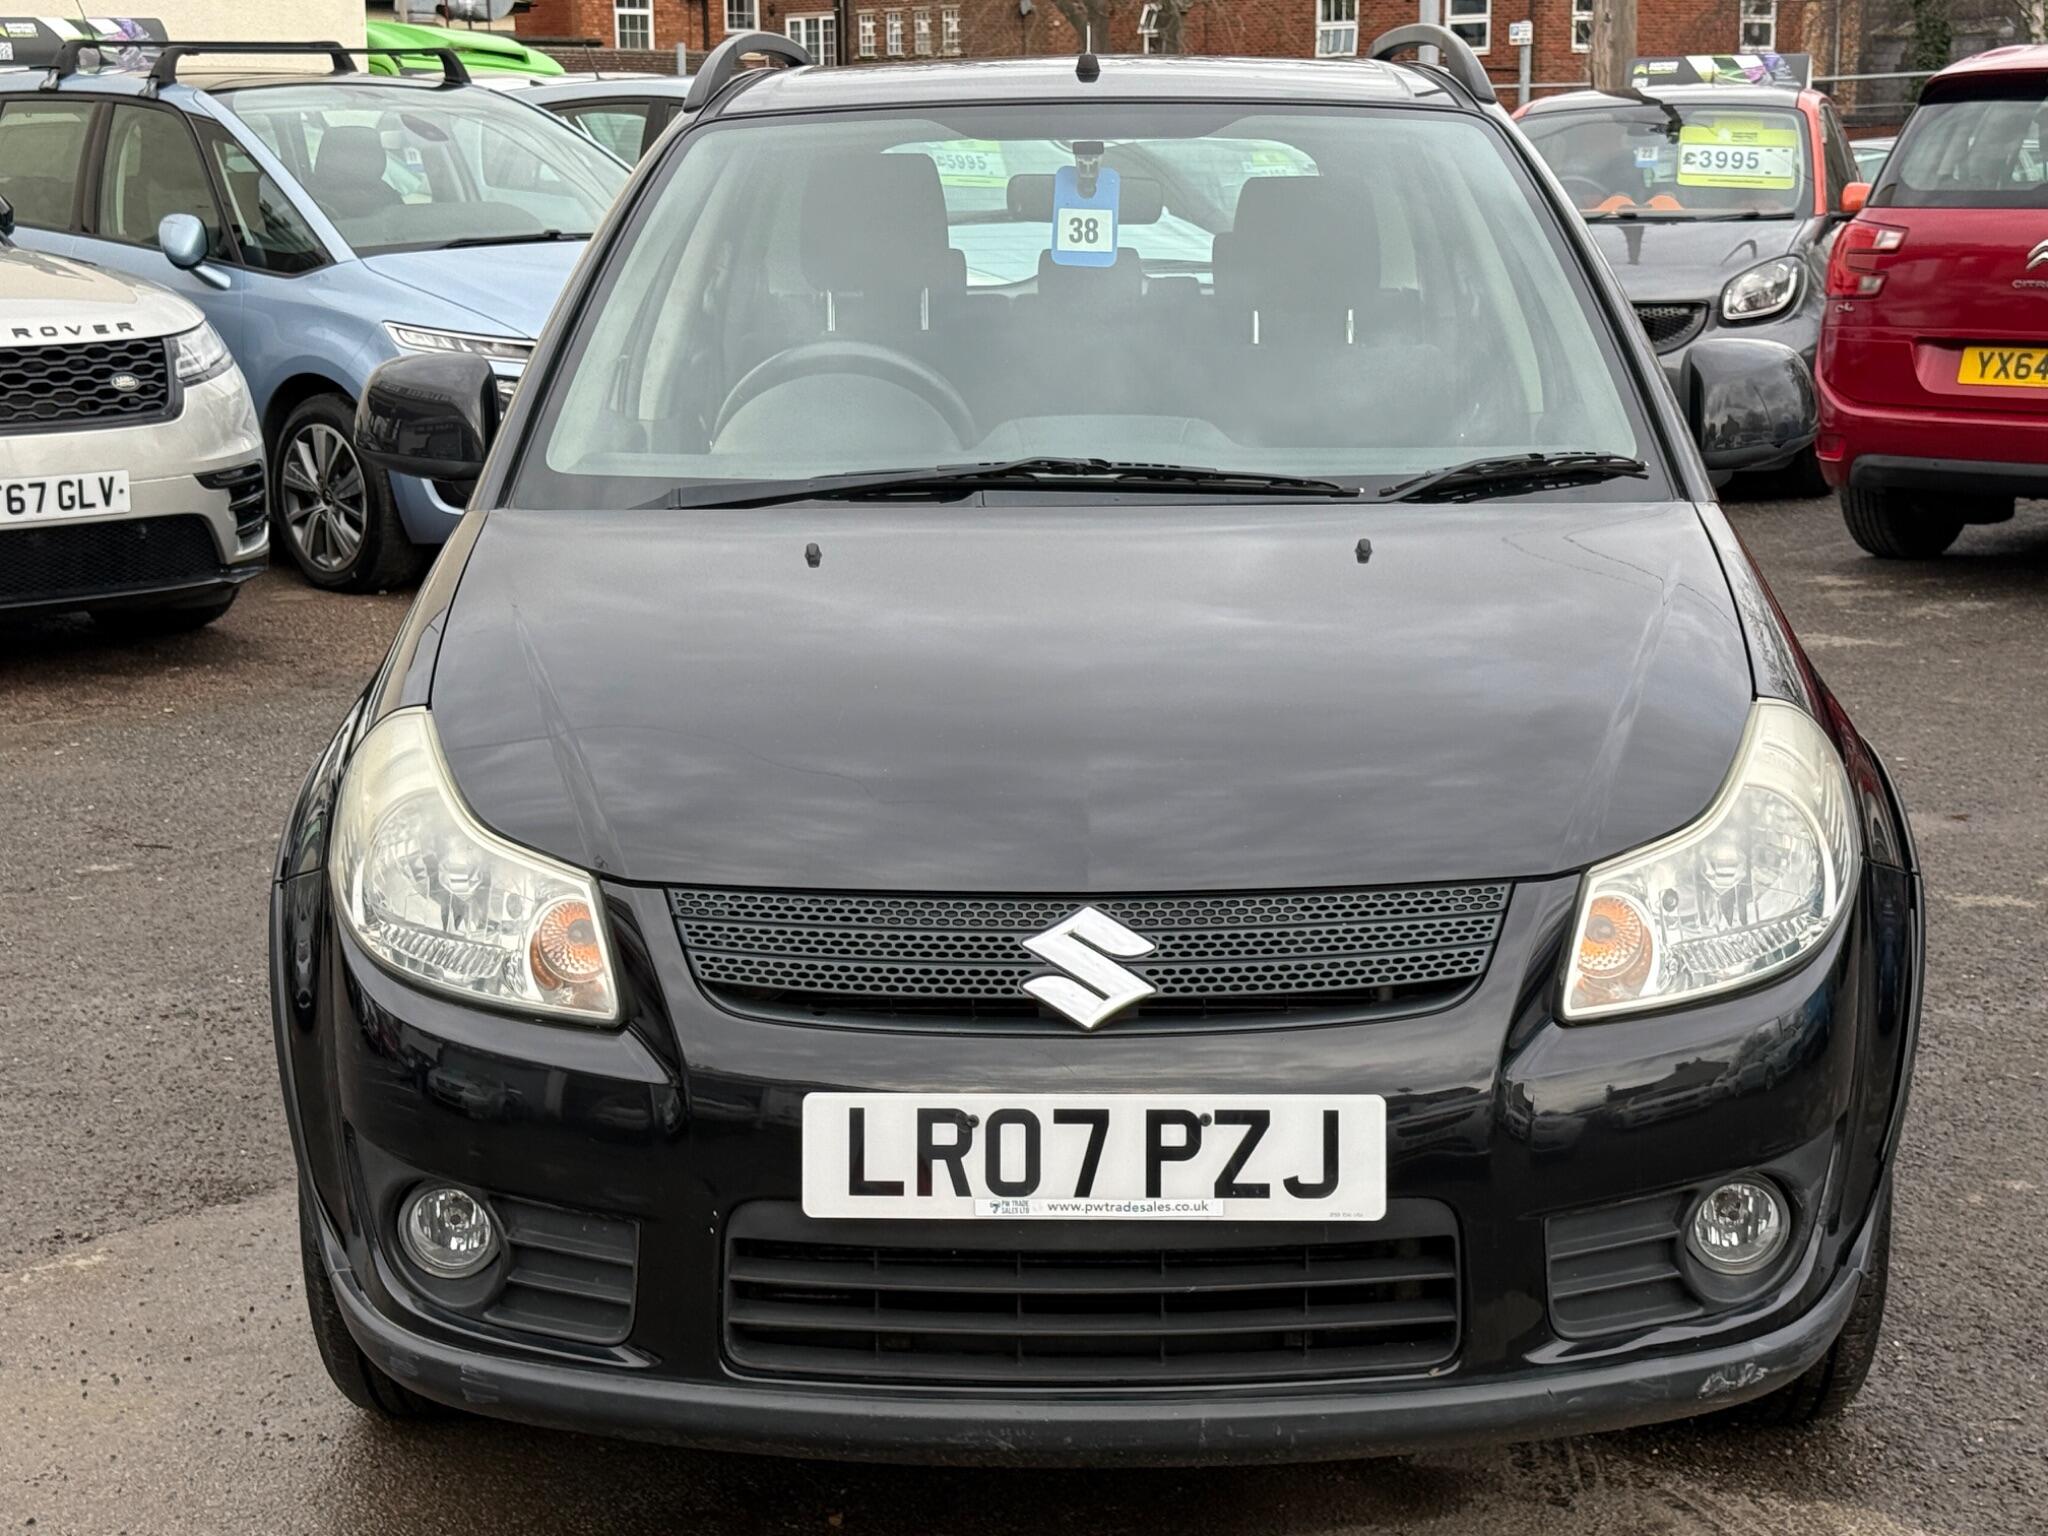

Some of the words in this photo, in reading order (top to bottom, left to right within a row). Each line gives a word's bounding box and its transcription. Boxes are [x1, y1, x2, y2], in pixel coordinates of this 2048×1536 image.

[1682, 150, 1760, 170] £3995
[1069, 217, 1099, 244] 38
[2012, 279, 2048, 289] CITR
[11, 322, 135, 338] ROVER
[1978, 351, 2048, 381] YX64
[0, 482, 47, 515] 67
[57, 476, 115, 511] GLV
[849, 1107, 1110, 1198] LR07
[1146, 1109, 1339, 1199] PZJ
[1047, 1200, 1209, 1214] www.pwtradesales.co.uk
